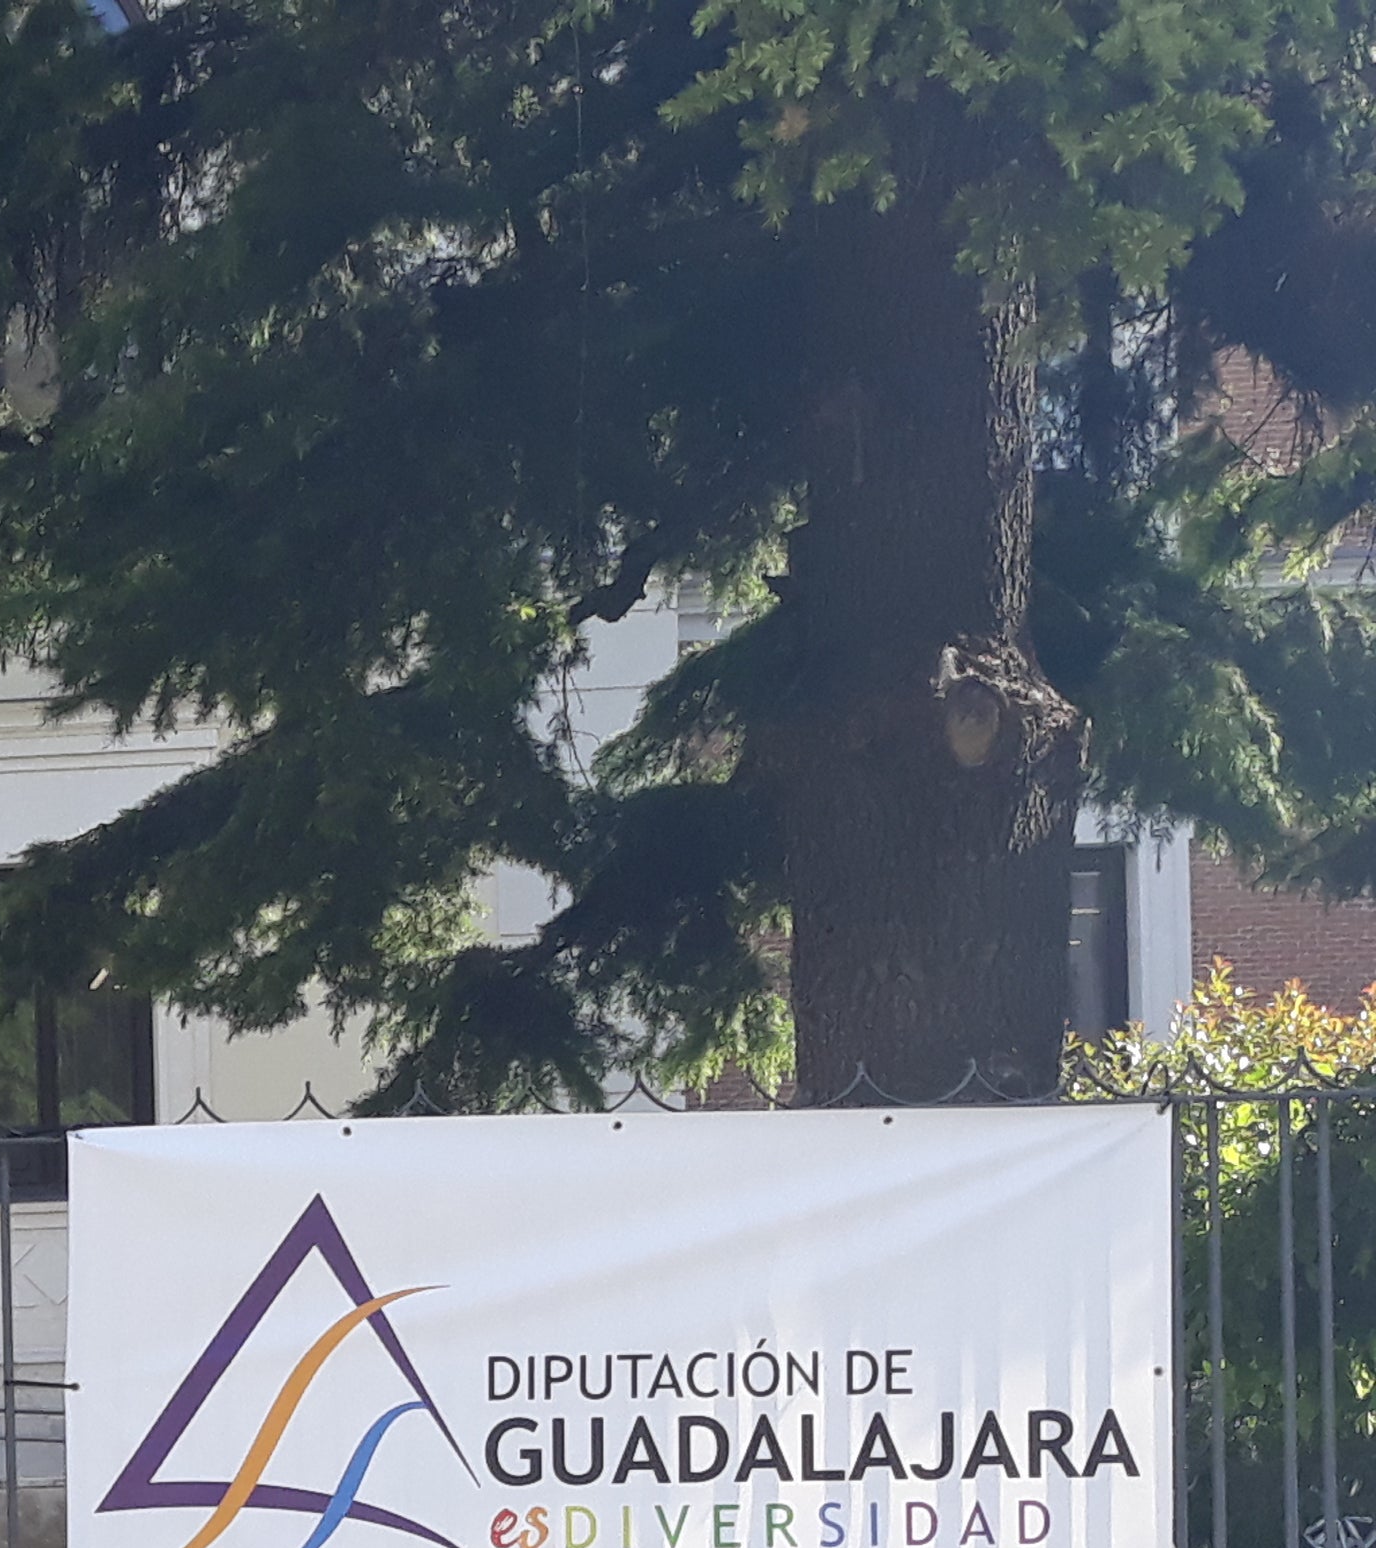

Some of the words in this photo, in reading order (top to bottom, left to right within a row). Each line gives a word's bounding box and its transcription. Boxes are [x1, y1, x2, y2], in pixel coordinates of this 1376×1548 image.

[486, 1337, 819, 1402] DIPUTACIÓN
[845, 1349, 913, 1396] DE
[484, 1408, 1141, 1486] GUADALAJARA
